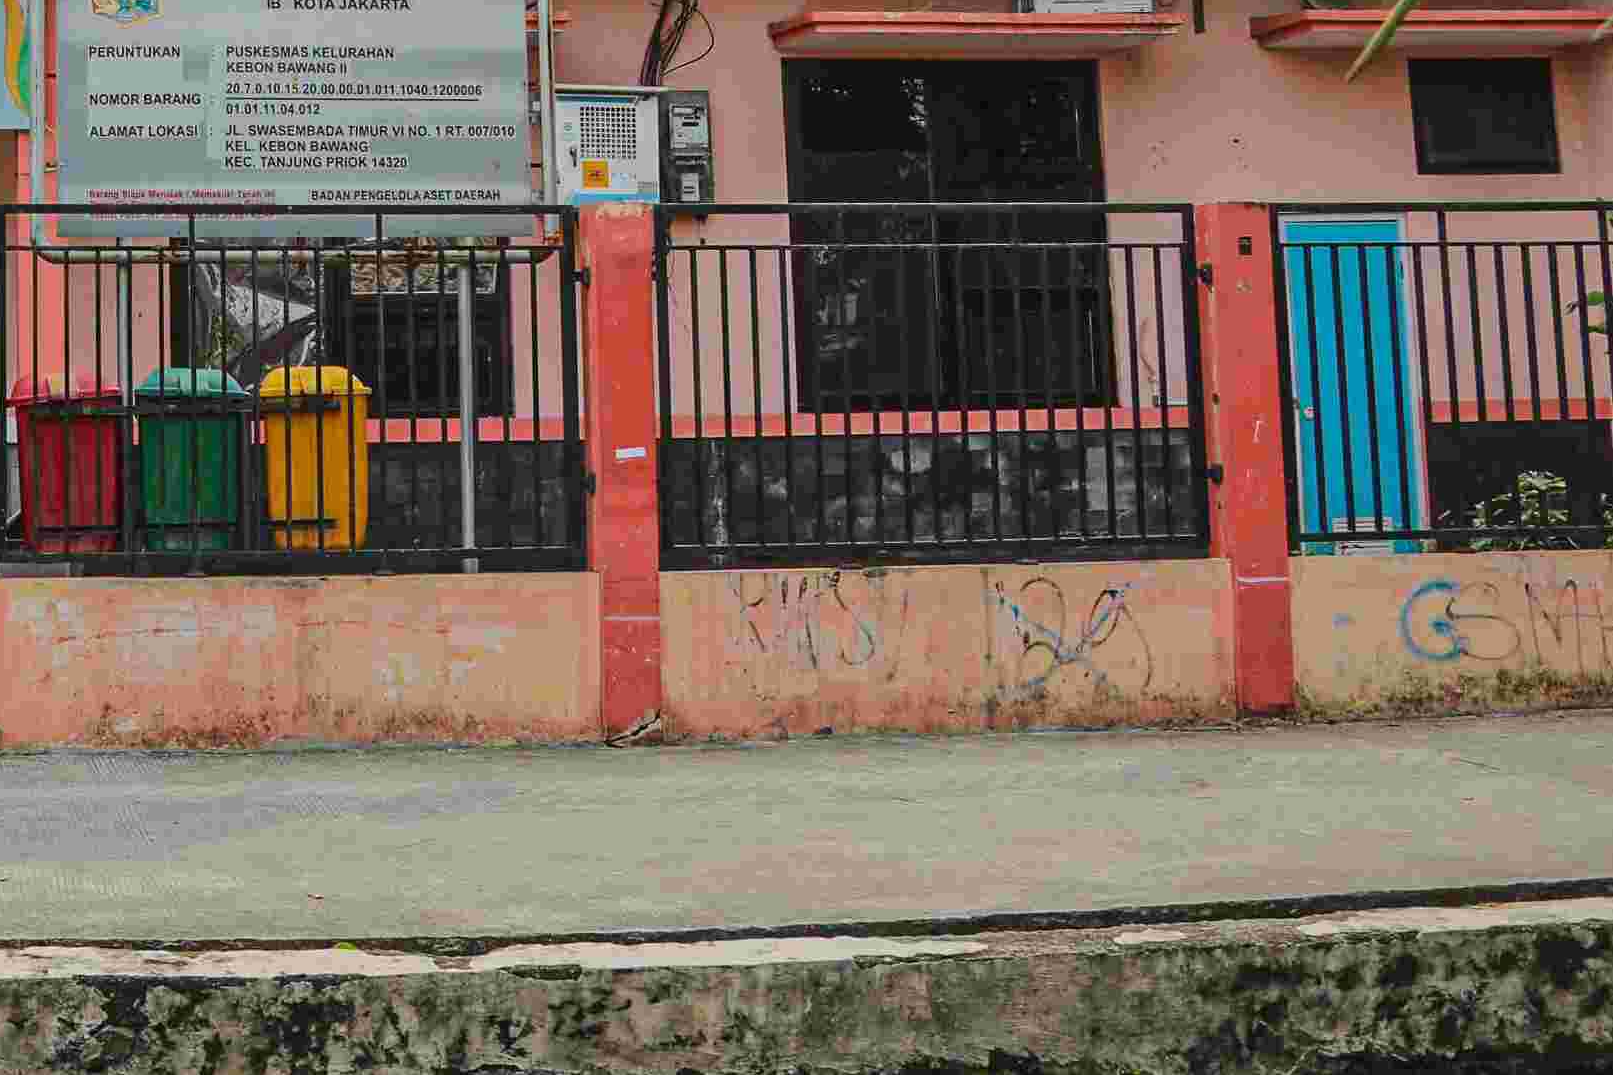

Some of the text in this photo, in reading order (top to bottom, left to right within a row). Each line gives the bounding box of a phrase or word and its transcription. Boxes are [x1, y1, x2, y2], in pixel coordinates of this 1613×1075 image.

[88, 46, 180, 58] PERUNTUKAN
[226, 46, 395, 59] PUSKESMAS KELURAHAN
[226, 61, 348, 74] KEBON BAWANG II
[89, 94, 202, 106] NOMOR BARANG
[90, 126, 144, 137] ALAMAT
[148, 126, 198, 137] LOKASI
[247, 125, 344, 137] SWASEMBADA
[347, 126, 389, 137] TIMUR
[392, 126, 405, 137] VI
[408, 126, 432, 137] NO.
[435, 126, 441, 137] 1
[445, 126, 466, 137] RT.
[468, 126, 516, 137] 007/010
[225, 141, 370, 153] KEL. KEBON BAWANG
[225, 156, 408, 168] KEC. TANJUNG PRIOK 14320
[311, 190, 501, 201] BADAN PENGELOLA ASET DAERAH
